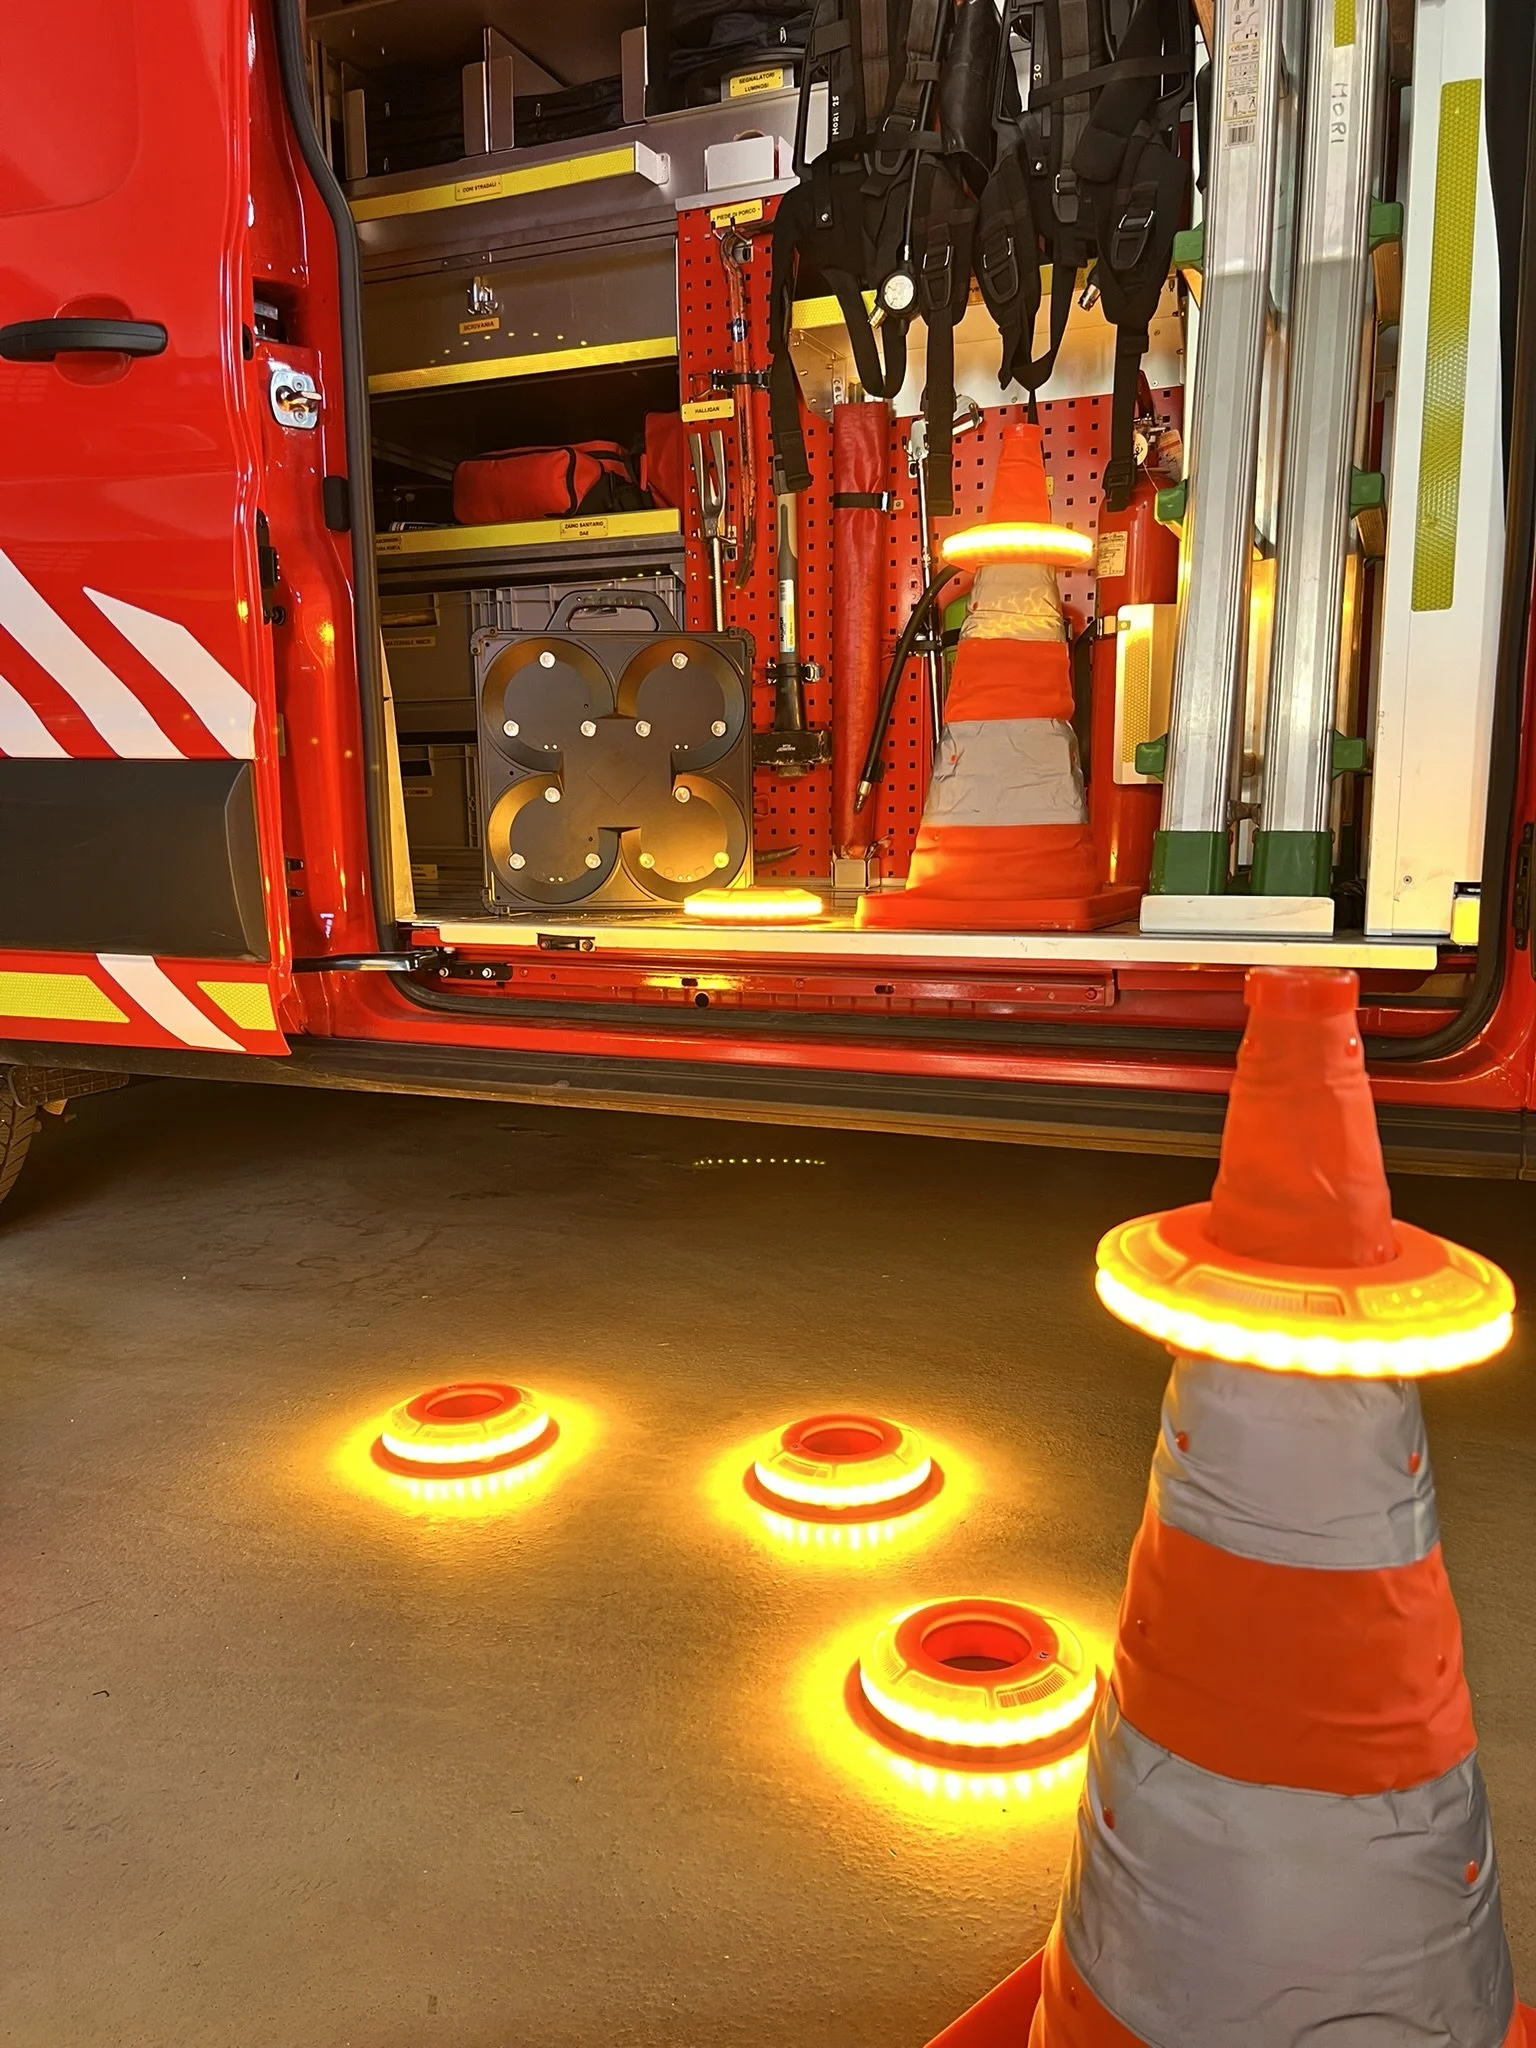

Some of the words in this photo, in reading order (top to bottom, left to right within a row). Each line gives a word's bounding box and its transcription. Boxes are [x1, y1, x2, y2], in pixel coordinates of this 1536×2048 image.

[739, 72, 775, 84] SEGNALATORI
[1033, 64, 1042, 81] 30
[745, 83, 769, 92] LUMINOSI
[831, 95, 840, 107] 25
[1331, 83, 1348, 144] MORI
[832, 112, 840, 135] MORI
[475, 181, 497, 191] STRADALI
[738, 207, 757, 216] PORCO
